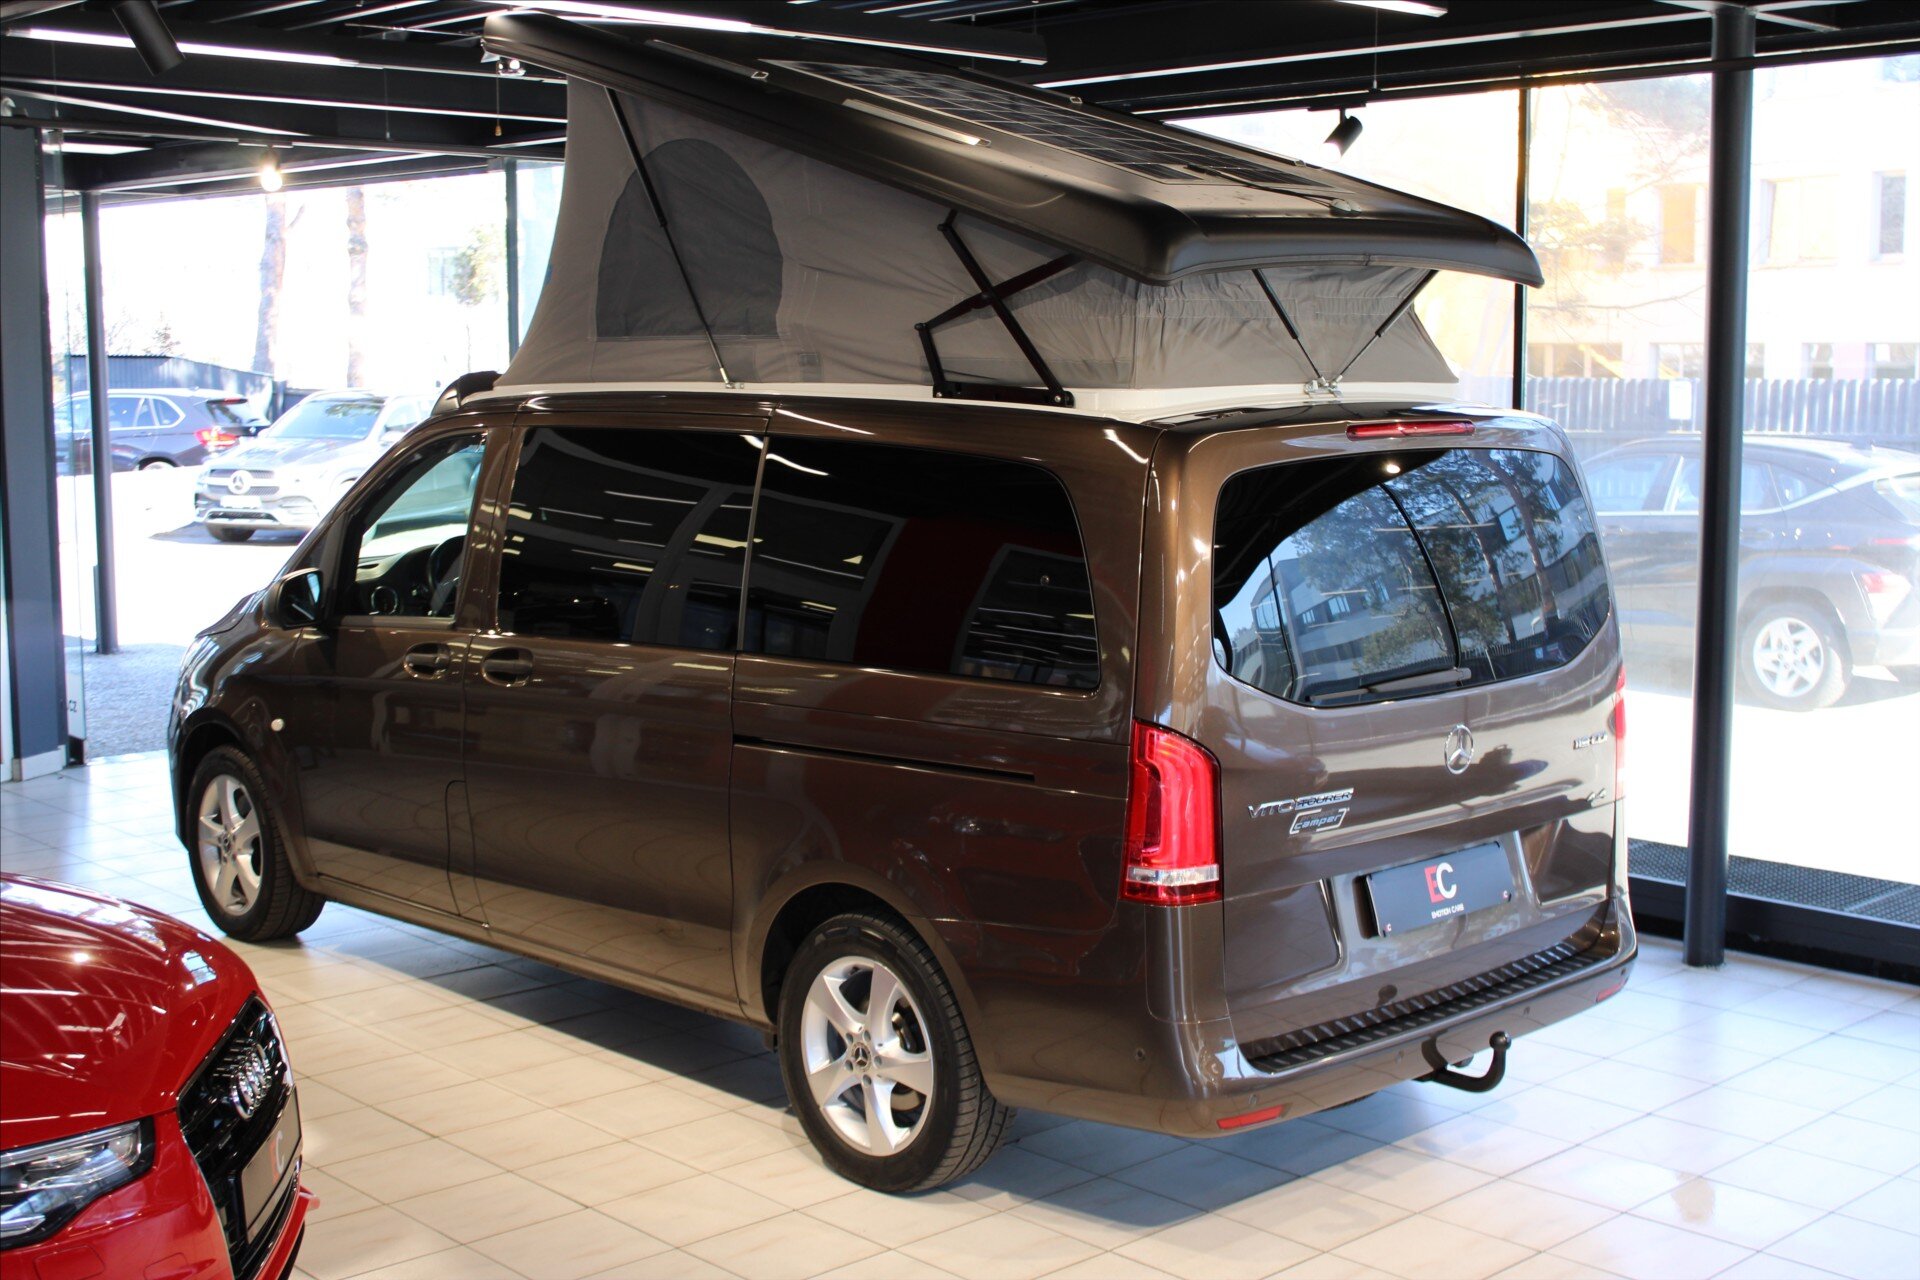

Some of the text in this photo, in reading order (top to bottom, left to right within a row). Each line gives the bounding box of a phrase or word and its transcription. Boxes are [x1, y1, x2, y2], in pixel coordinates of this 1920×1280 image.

[1248, 799, 1296, 819] VITO
[1293, 814, 1342, 831] camper
[1424, 862, 1457, 904] EC
[1431, 907, 1452, 920] EMOTION
